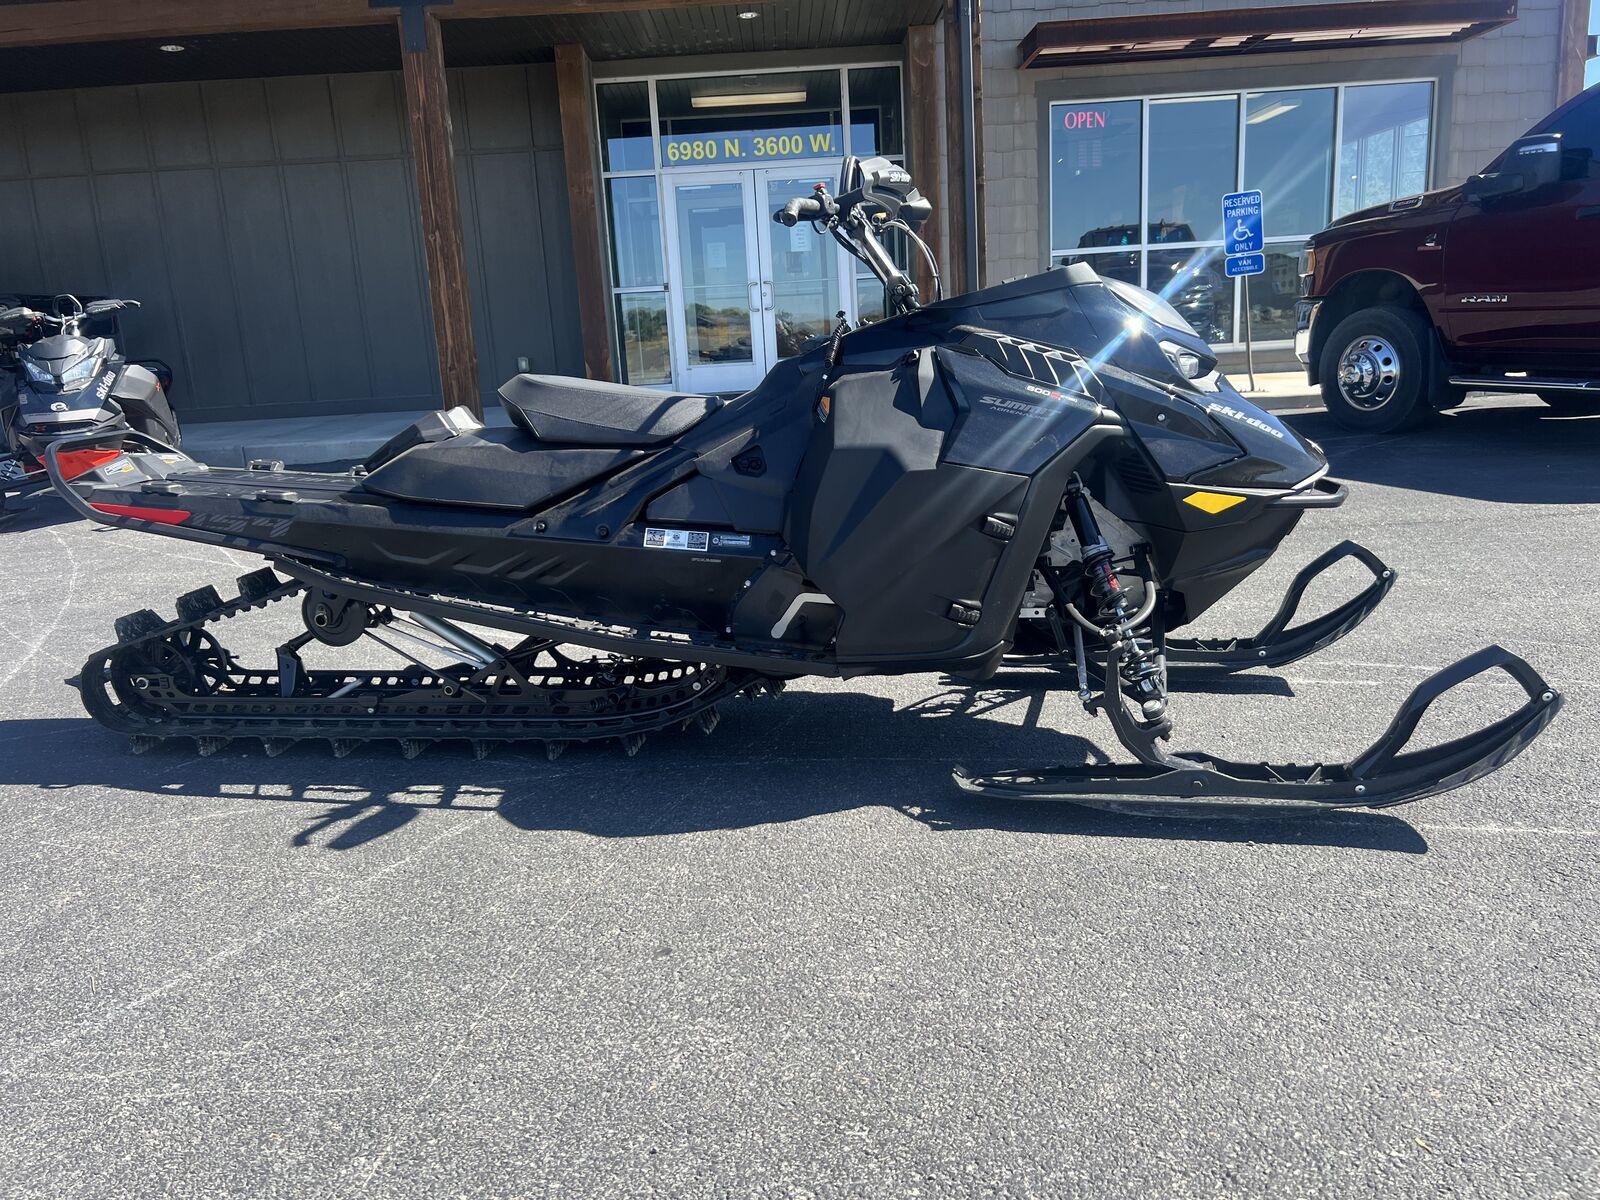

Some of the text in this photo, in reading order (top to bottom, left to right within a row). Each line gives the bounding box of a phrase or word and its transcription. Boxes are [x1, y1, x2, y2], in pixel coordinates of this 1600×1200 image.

[1064, 111, 1106, 129] OPEN
[667, 132, 836, 161] 6980 N. 3600 W.
[1224, 195, 1260, 207] RESERVED
[1227, 206, 1258, 217] PARKING
[1235, 242, 1253, 251] ONLY
